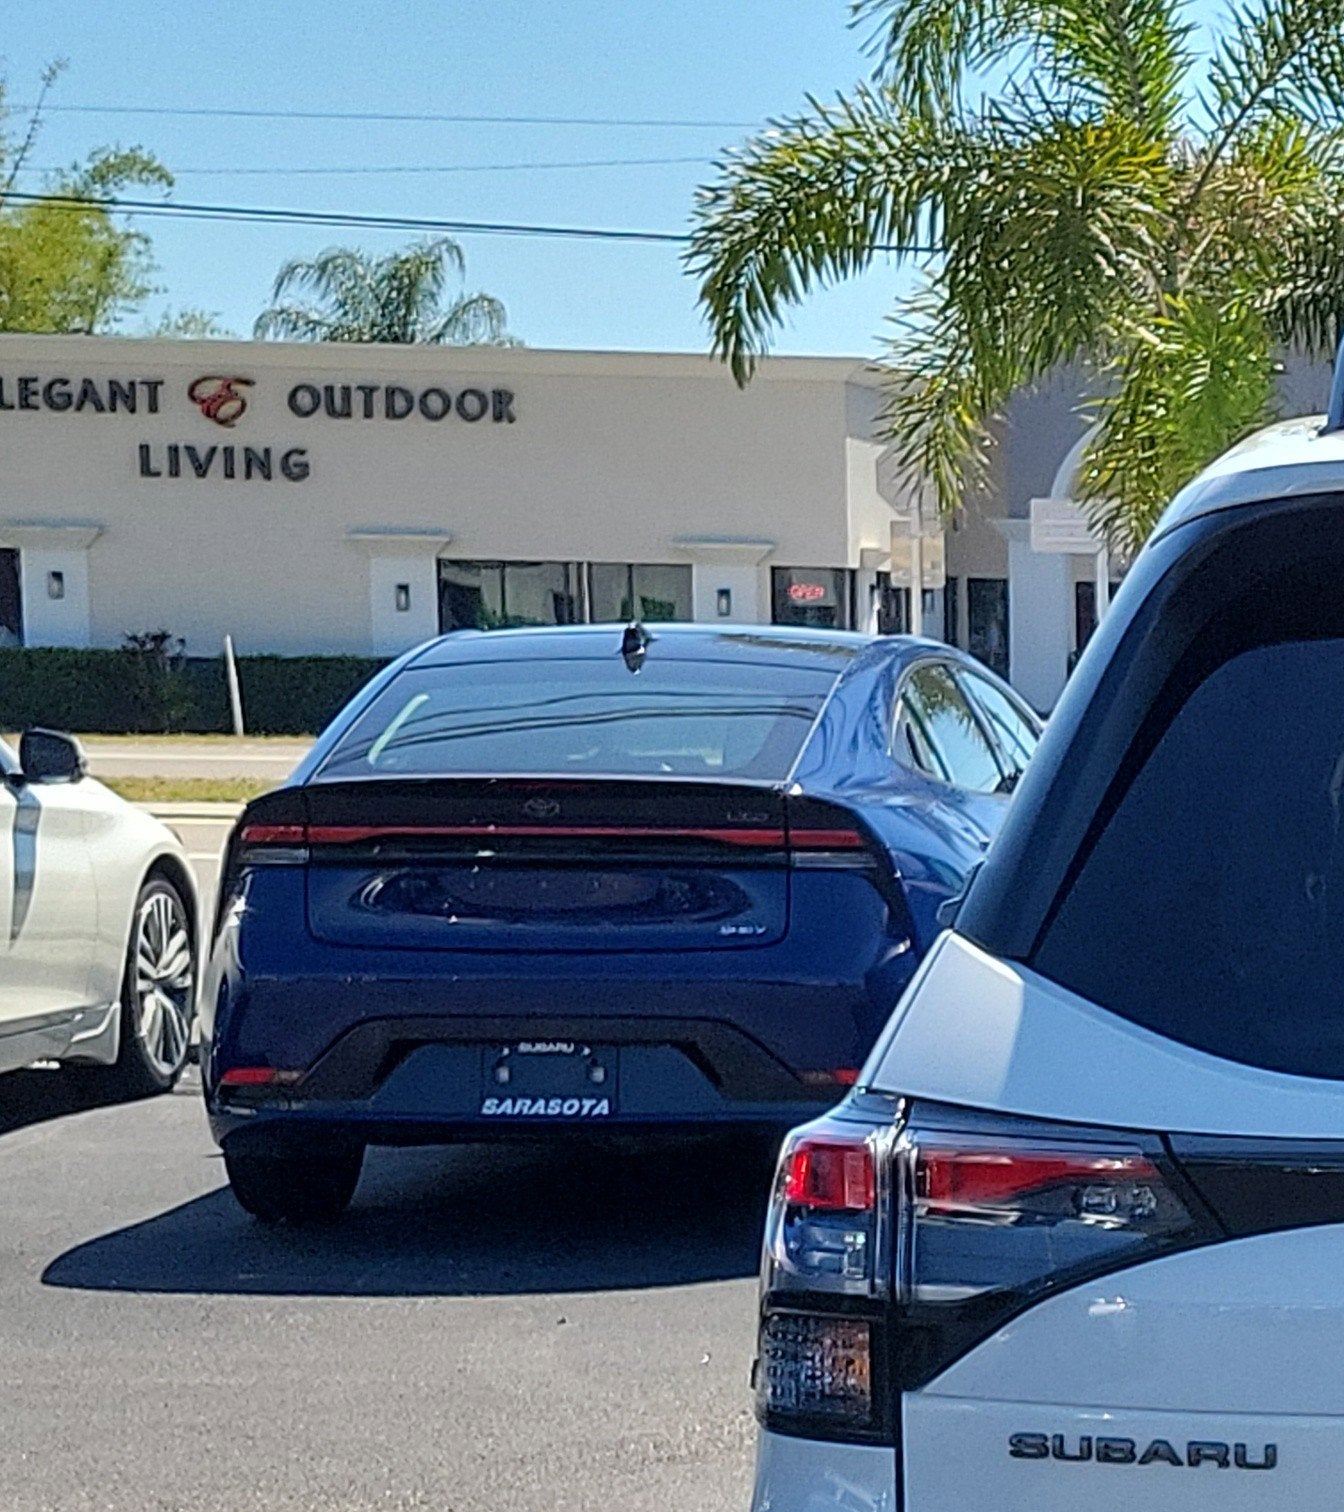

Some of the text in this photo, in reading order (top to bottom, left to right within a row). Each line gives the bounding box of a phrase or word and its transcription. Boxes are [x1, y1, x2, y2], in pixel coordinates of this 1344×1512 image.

[288, 383, 516, 424] OUTDOOR
[139, 443, 311, 482] LIVING
[481, 1098, 609, 1116] SARASOTA
[1008, 1432, 1278, 1470] SUBARU
